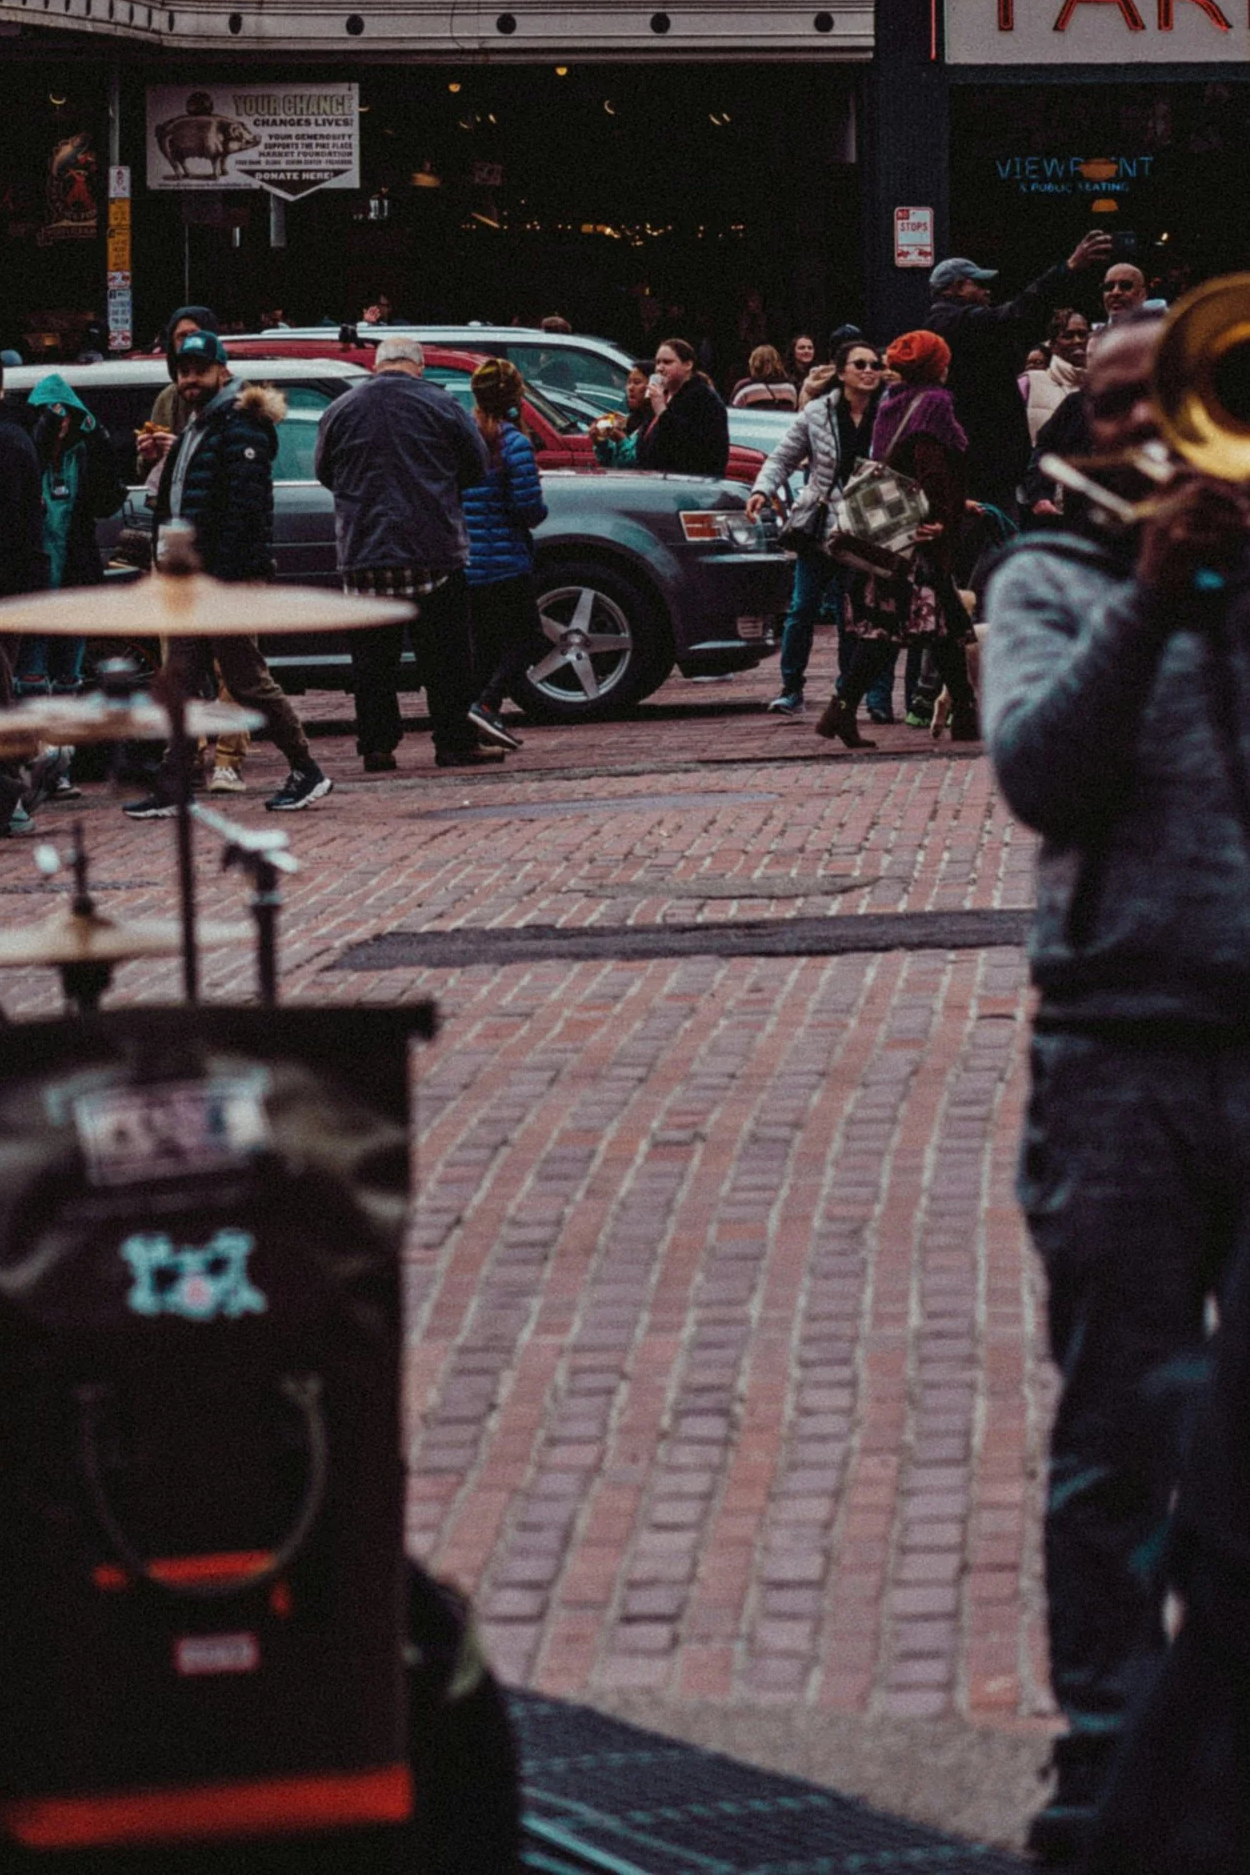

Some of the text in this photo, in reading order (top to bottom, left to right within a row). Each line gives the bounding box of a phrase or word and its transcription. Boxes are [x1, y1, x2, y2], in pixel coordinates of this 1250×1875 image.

[233, 94, 354, 116] YOUR CHANGE
[253, 118, 353, 127] CHANGES LIVES!
[996, 156, 1154, 180] VIEWPNT
[255, 172, 334, 180] DONATE HERE!
[900, 222, 928, 232] STOPS
